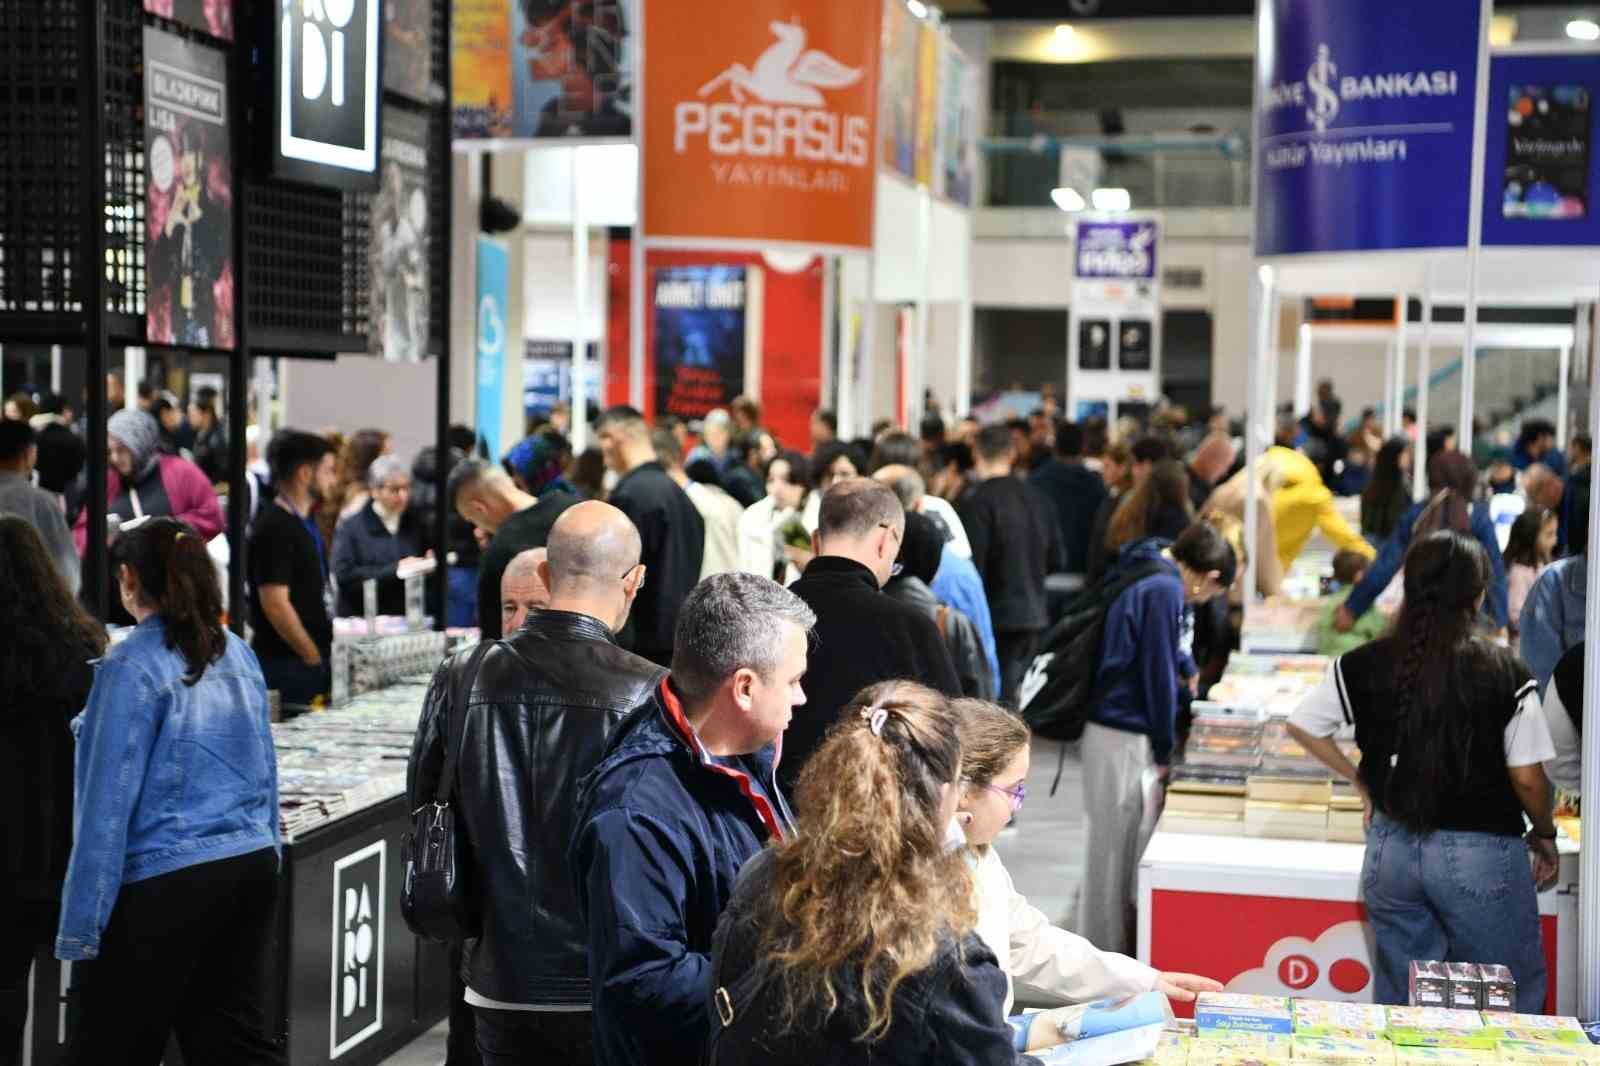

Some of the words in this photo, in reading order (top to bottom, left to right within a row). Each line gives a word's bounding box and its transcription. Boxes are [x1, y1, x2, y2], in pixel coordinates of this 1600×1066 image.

[1340, 71, 1458, 101] BANKASI
[674, 102, 867, 167] PEGASUS
[1309, 138, 1408, 168] Yayınları
[712, 162, 847, 191] YAYINLARI
[1288, 960, 1309, 985] D
